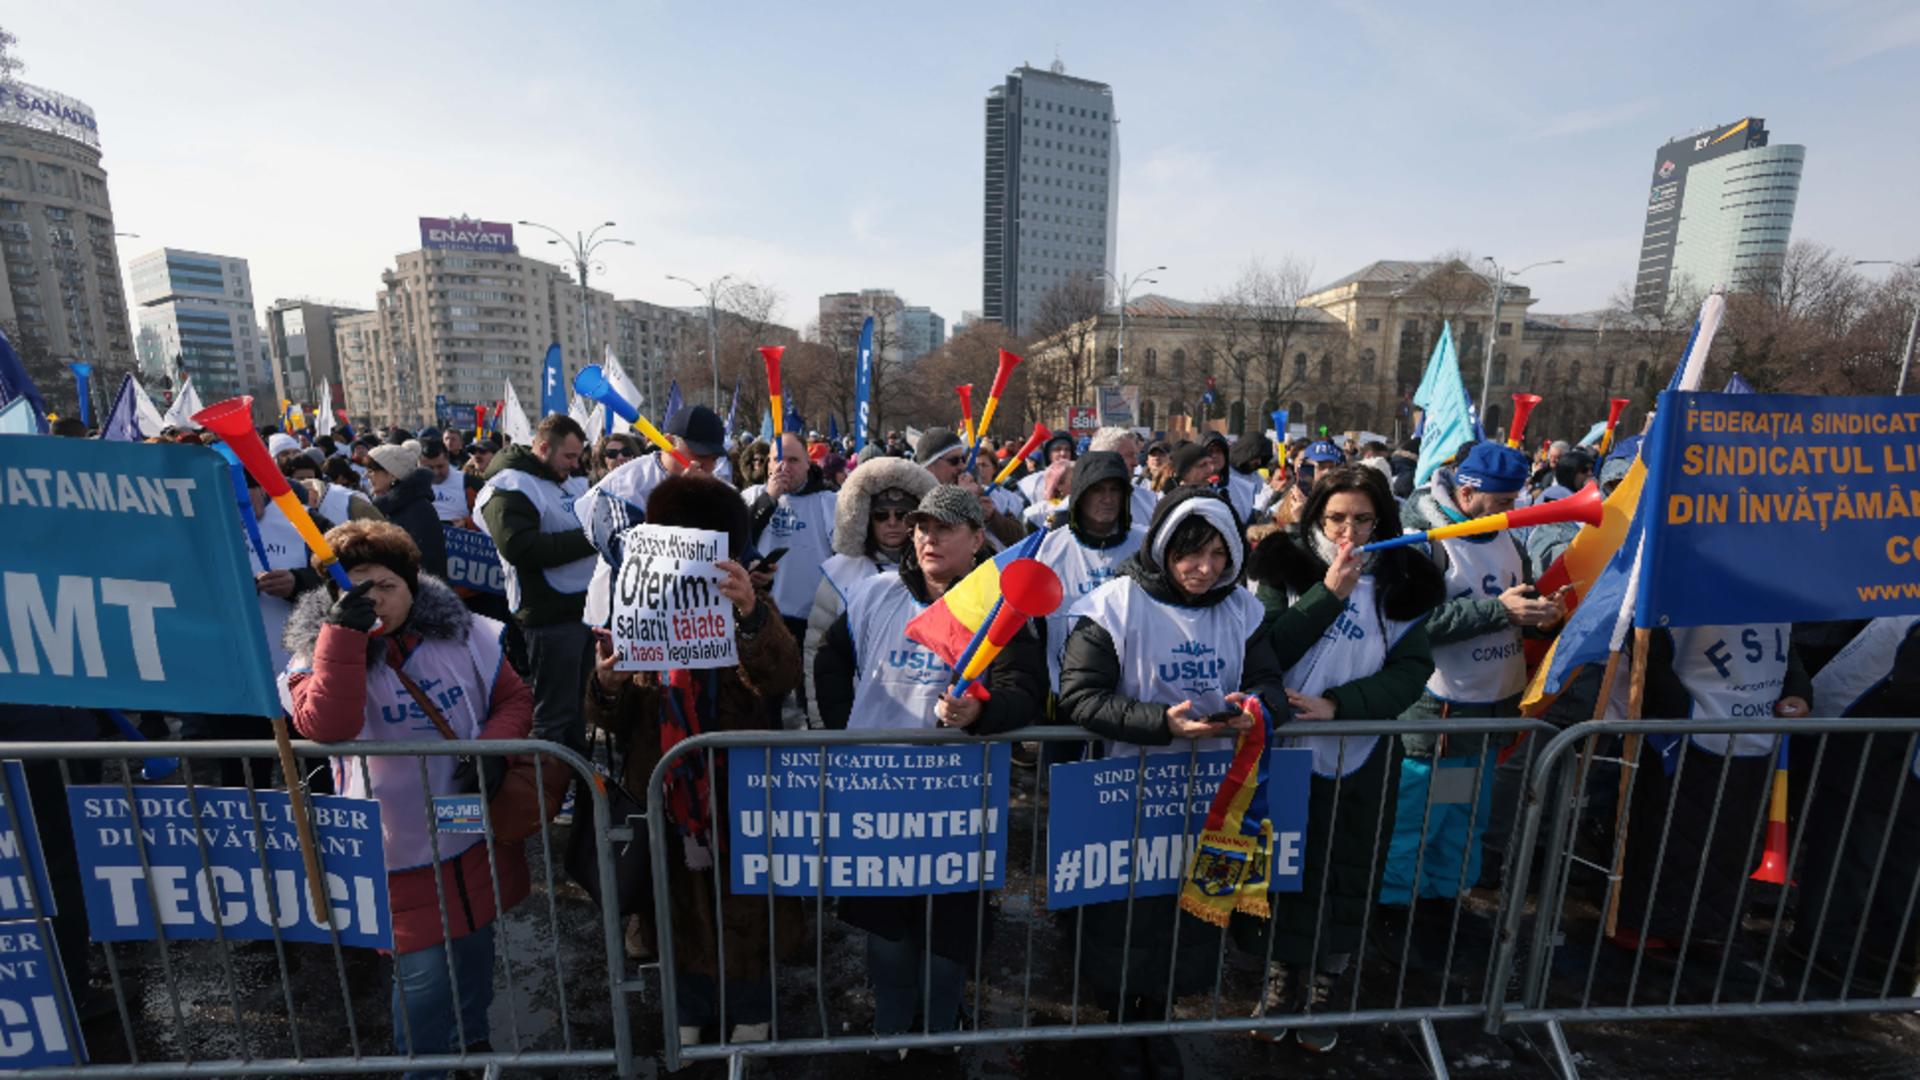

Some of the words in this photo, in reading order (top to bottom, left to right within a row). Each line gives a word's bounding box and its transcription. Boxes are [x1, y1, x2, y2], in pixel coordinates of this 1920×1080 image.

[1694, 136, 1711, 151] EY
[428, 228, 505, 245] ENAYATI
[1687, 410, 1803, 440] FEDERAȚIA
[1682, 444, 1873, 475] SINDICATUL
[1884, 444, 1920, 473] LI
[0, 467, 197, 517] ATAMANT
[1667, 494, 1728, 525] DIN
[621, 555, 719, 610] Oferim:
[0, 572, 177, 681] MT
[617, 609, 668, 643] salarii
[672, 609, 726, 640] tăiate
[631, 642, 664, 662] haos
[1159, 657, 1226, 682] USLIP
[781, 753, 899, 769] SINDICATUL
[904, 755, 962, 768] LIBER
[748, 774, 781, 788] DIN
[922, 773, 993, 788] TECUCI
[85, 799, 277, 822] SINDICATUL
[1099, 788, 1129, 804] DIN
[98, 828, 156, 847] DIN
[741, 810, 840, 845] UNIȚI
[852, 808, 998, 839] SUNTEM
[742, 850, 997, 887] PUTERNICI!
[94, 866, 379, 935] TECUCI
